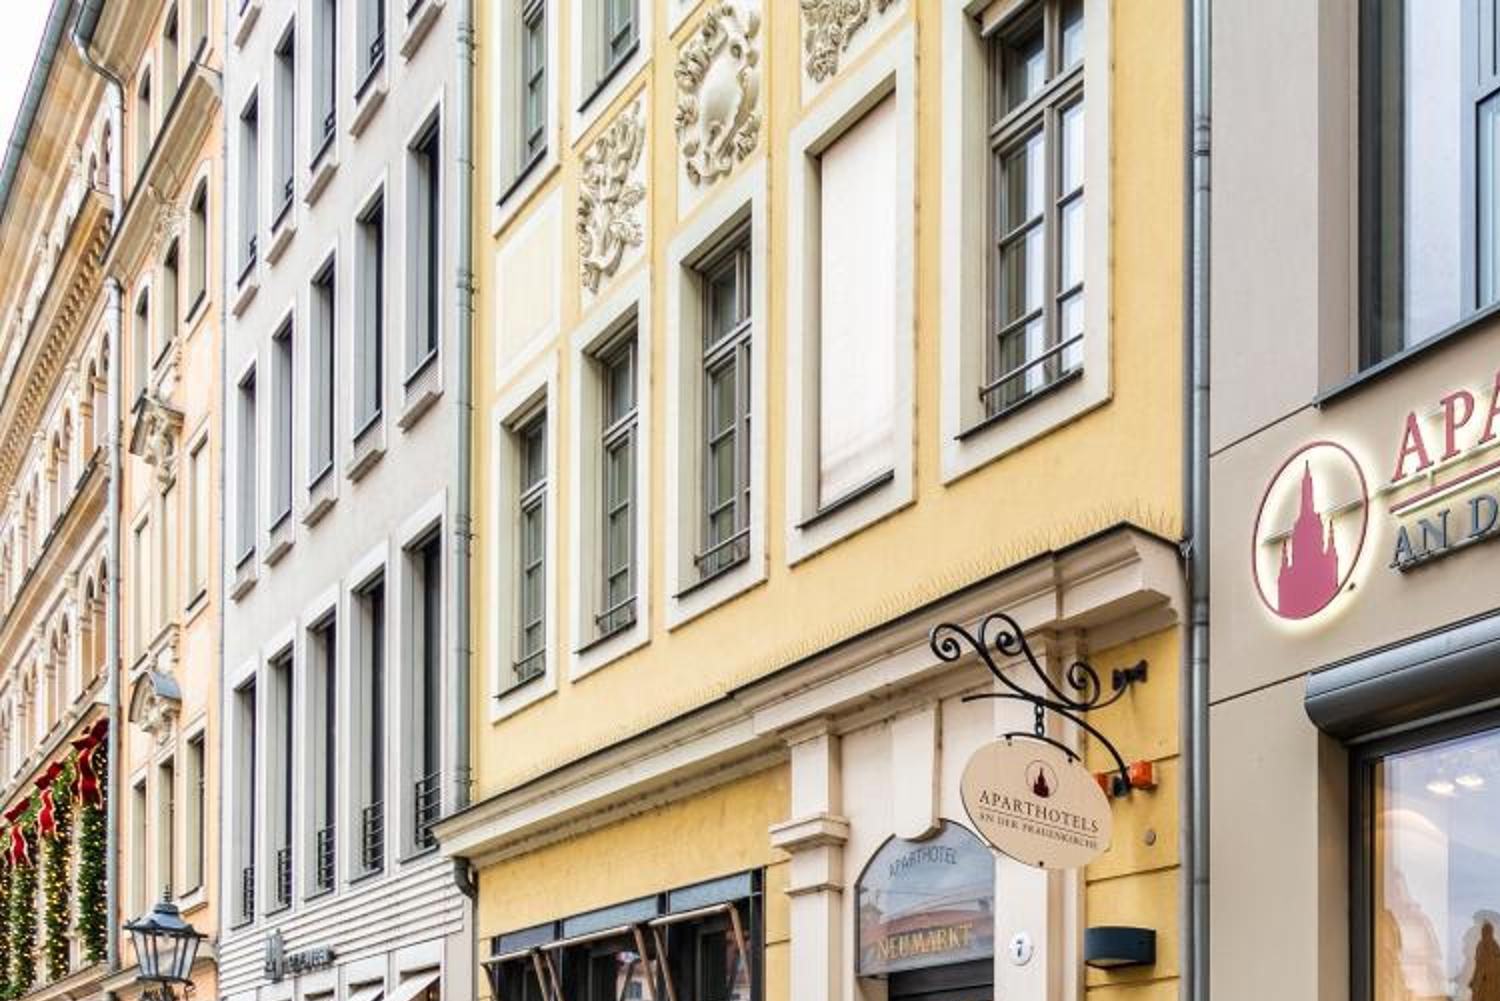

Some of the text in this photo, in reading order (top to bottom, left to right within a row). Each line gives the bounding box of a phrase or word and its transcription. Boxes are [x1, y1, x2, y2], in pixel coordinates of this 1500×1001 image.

[1389, 509, 1449, 570] AN
[979, 790, 1100, 834] APARTHOTELS
[877, 923, 974, 962] NEUMARKT
